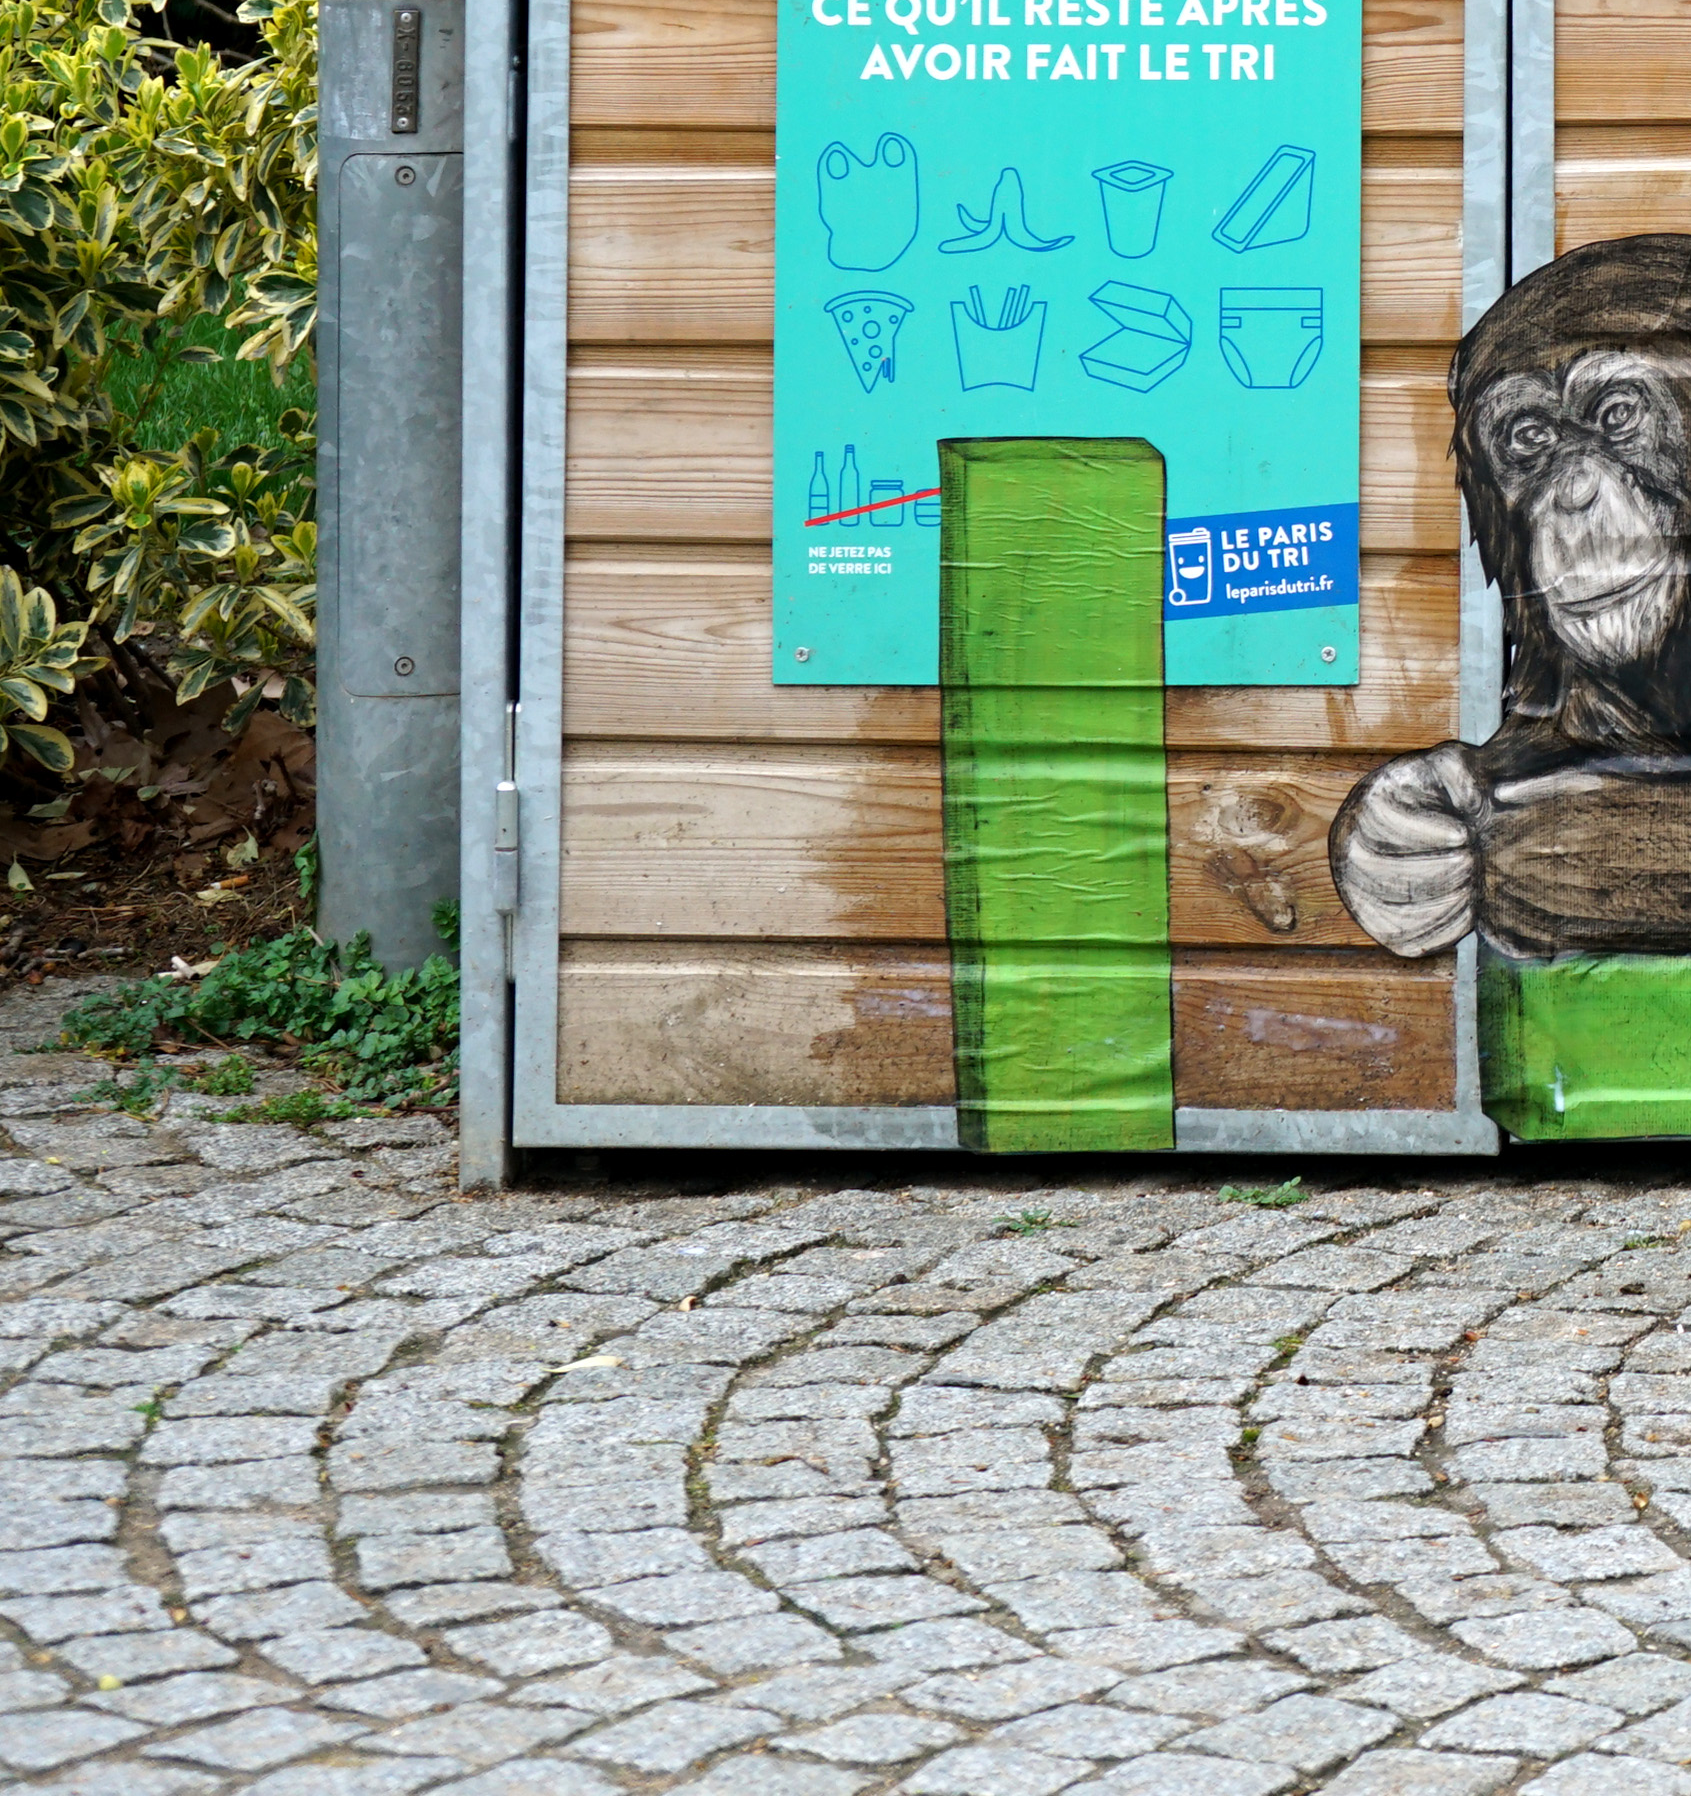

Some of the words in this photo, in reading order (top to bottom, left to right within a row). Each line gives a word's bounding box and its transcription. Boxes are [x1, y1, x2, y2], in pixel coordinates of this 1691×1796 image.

[859, 43, 1012, 81] AVOIR
[1026, 43, 1127, 81] FAIT
[1139, 43, 1190, 81] LE
[1201, 43, 1275, 81] TRI
[1220, 528, 1251, 551] LE
[1257, 521, 1334, 548] PARIS
[808, 546, 828, 558] NE
[828, 546, 866, 558] JETEZ
[867, 546, 892, 558] PAS
[1222, 551, 1260, 574] DU
[1266, 546, 1309, 568] TRI
[808, 562, 827, 575] DE
[828, 562, 872, 575] VERRE
[873, 562, 892, 575] ICI
[1225, 574, 1334, 604] leparisdutri.fr
